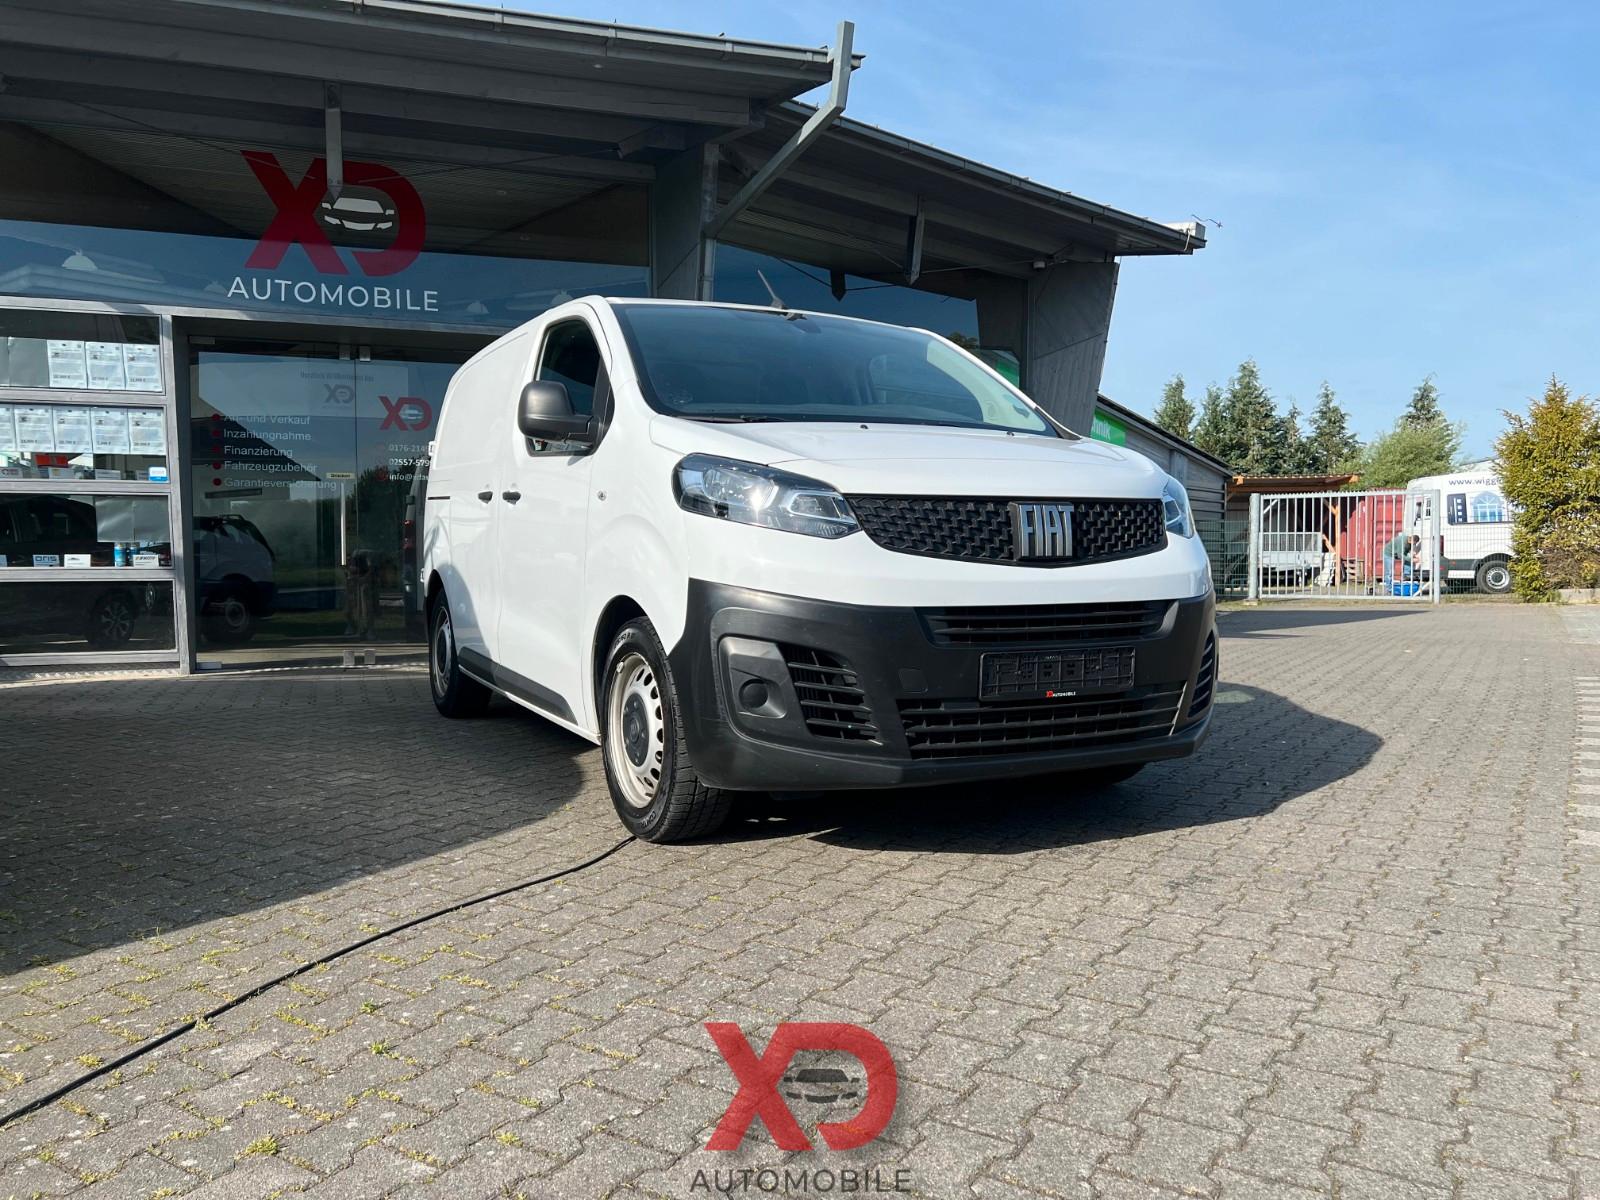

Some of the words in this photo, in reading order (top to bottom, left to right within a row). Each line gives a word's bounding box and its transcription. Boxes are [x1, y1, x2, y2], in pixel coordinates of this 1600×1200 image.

[227, 276, 439, 312] AUTOMOBILE
[270, 415, 311, 425] Verkauf
[223, 428, 312, 441] Inzahlungnahme
[223, 445, 294, 458] Finanzierung
[223, 460, 318, 473] Fahrzeugzubehör
[224, 477, 338, 491] Garantieversicherung
[1019, 504, 1075, 557] FIAT
